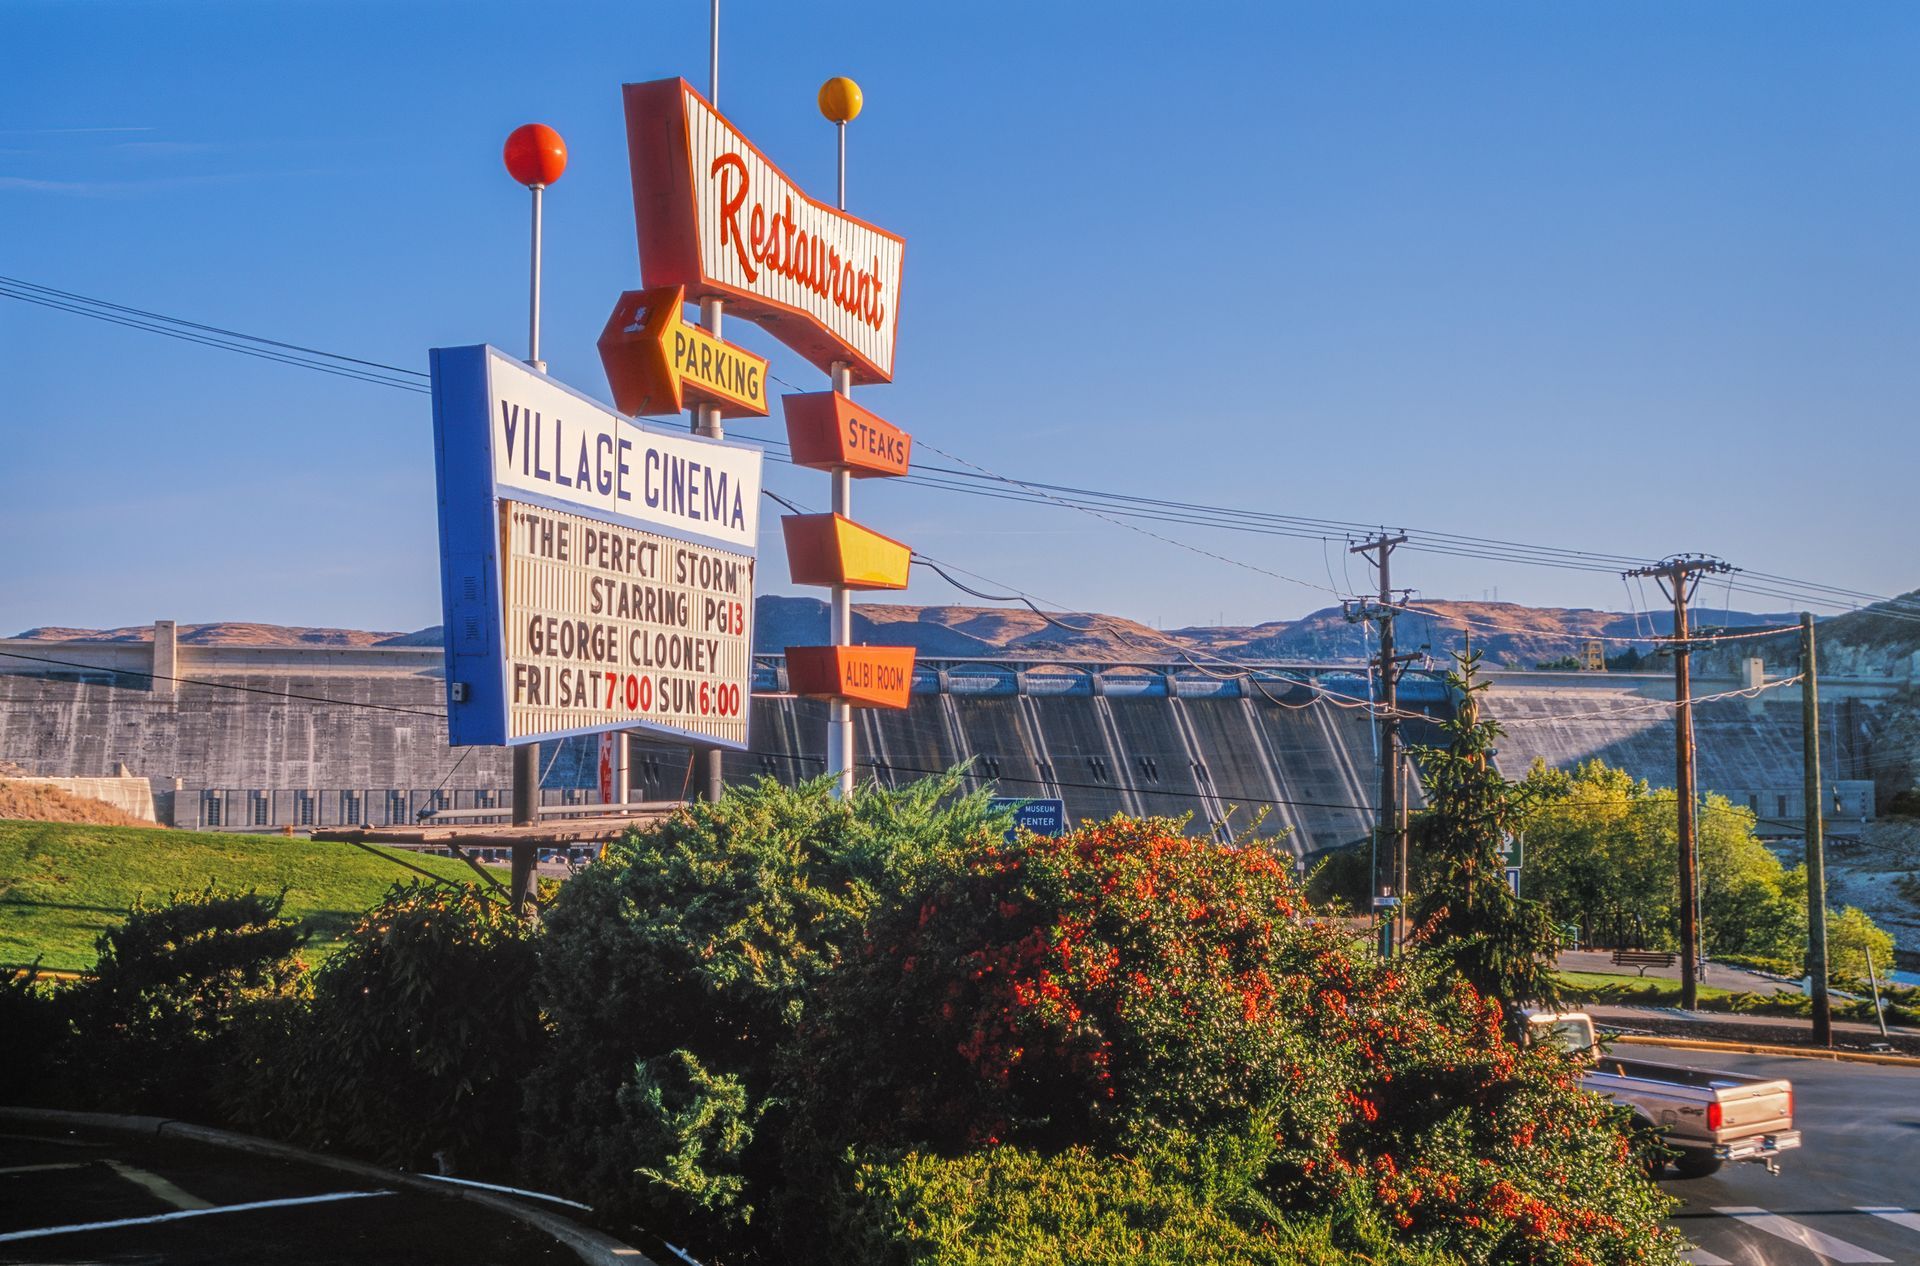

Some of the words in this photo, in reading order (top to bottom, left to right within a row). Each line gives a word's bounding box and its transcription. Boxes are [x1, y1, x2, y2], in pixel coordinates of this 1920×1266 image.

[711, 152, 885, 332] Restaurant
[675, 331, 758, 400] PARKING
[501, 399, 632, 501] VILLAGE
[644, 447, 746, 532] CINEMA
[849, 418, 904, 465] STEAKS
[584, 528, 659, 579] PERFCT
[591, 575, 688, 627] STARRING
[704, 597, 743, 636] PG13
[528, 614, 619, 663] GEORGE
[629, 629, 719, 674] CLOONEY
[513, 663, 551, 706] FRI
[559, 668, 602, 709] SAT
[605, 671, 651, 712] 7:00
[659, 676, 696, 715] SUN
[699, 680, 740, 717] 6:00
[846, 661, 873, 689] ALIBI
[877, 664, 904, 692] ROOM
[1020, 817, 1055, 826] CENTER
[1025, 805, 1056, 813] MUSEUM
